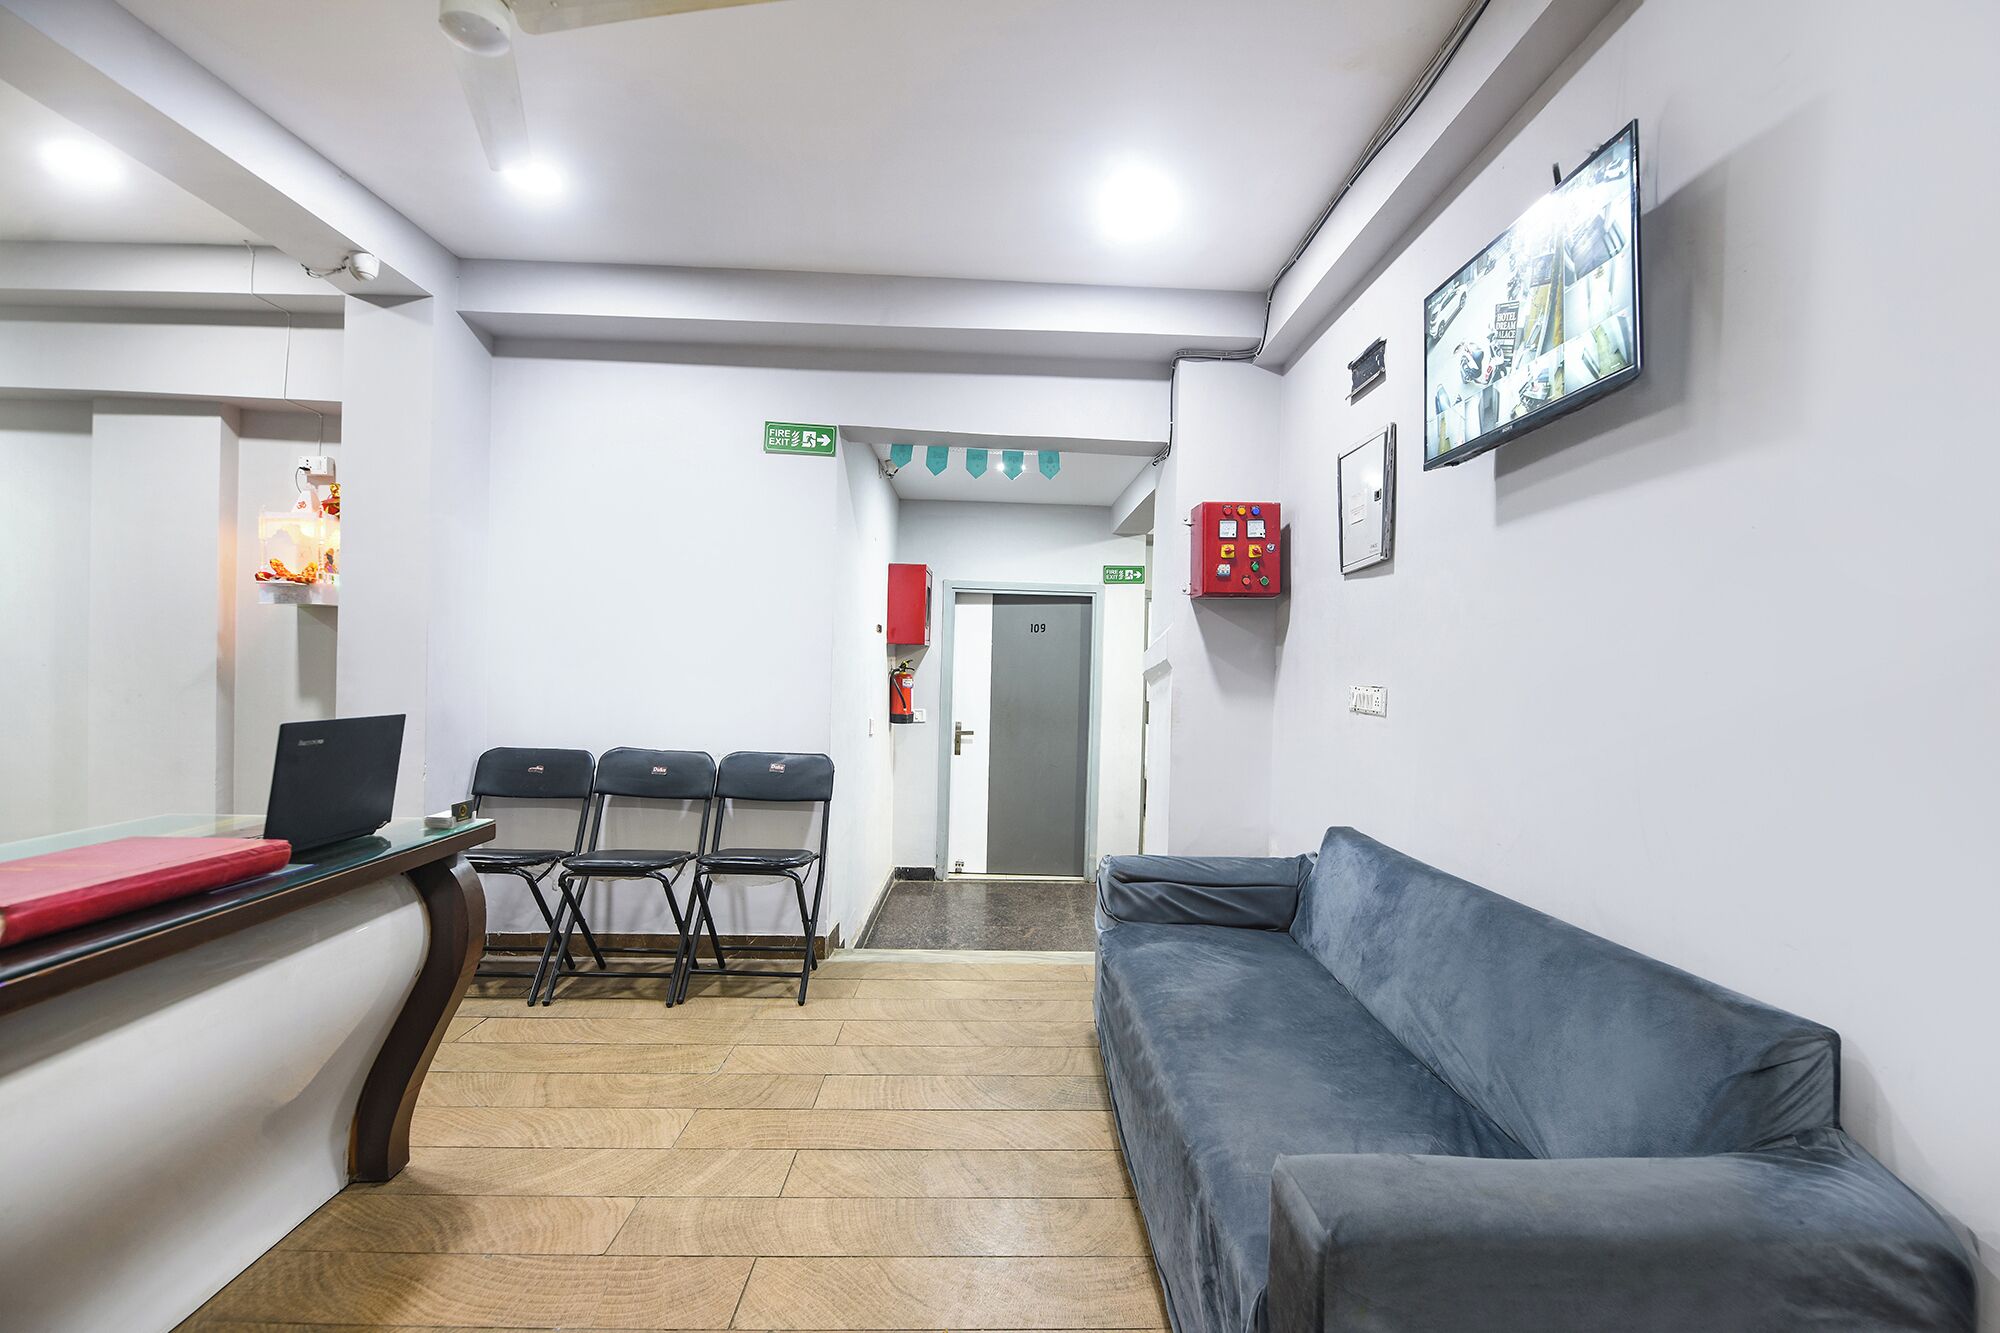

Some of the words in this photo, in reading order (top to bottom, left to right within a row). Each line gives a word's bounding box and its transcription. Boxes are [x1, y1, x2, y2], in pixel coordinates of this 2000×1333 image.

[1496, 312, 1517, 322] HOTEL
[769, 428, 791, 438] FIRE
[768, 437, 790, 446] EXIT
[1030, 623, 1046, 633] 109
